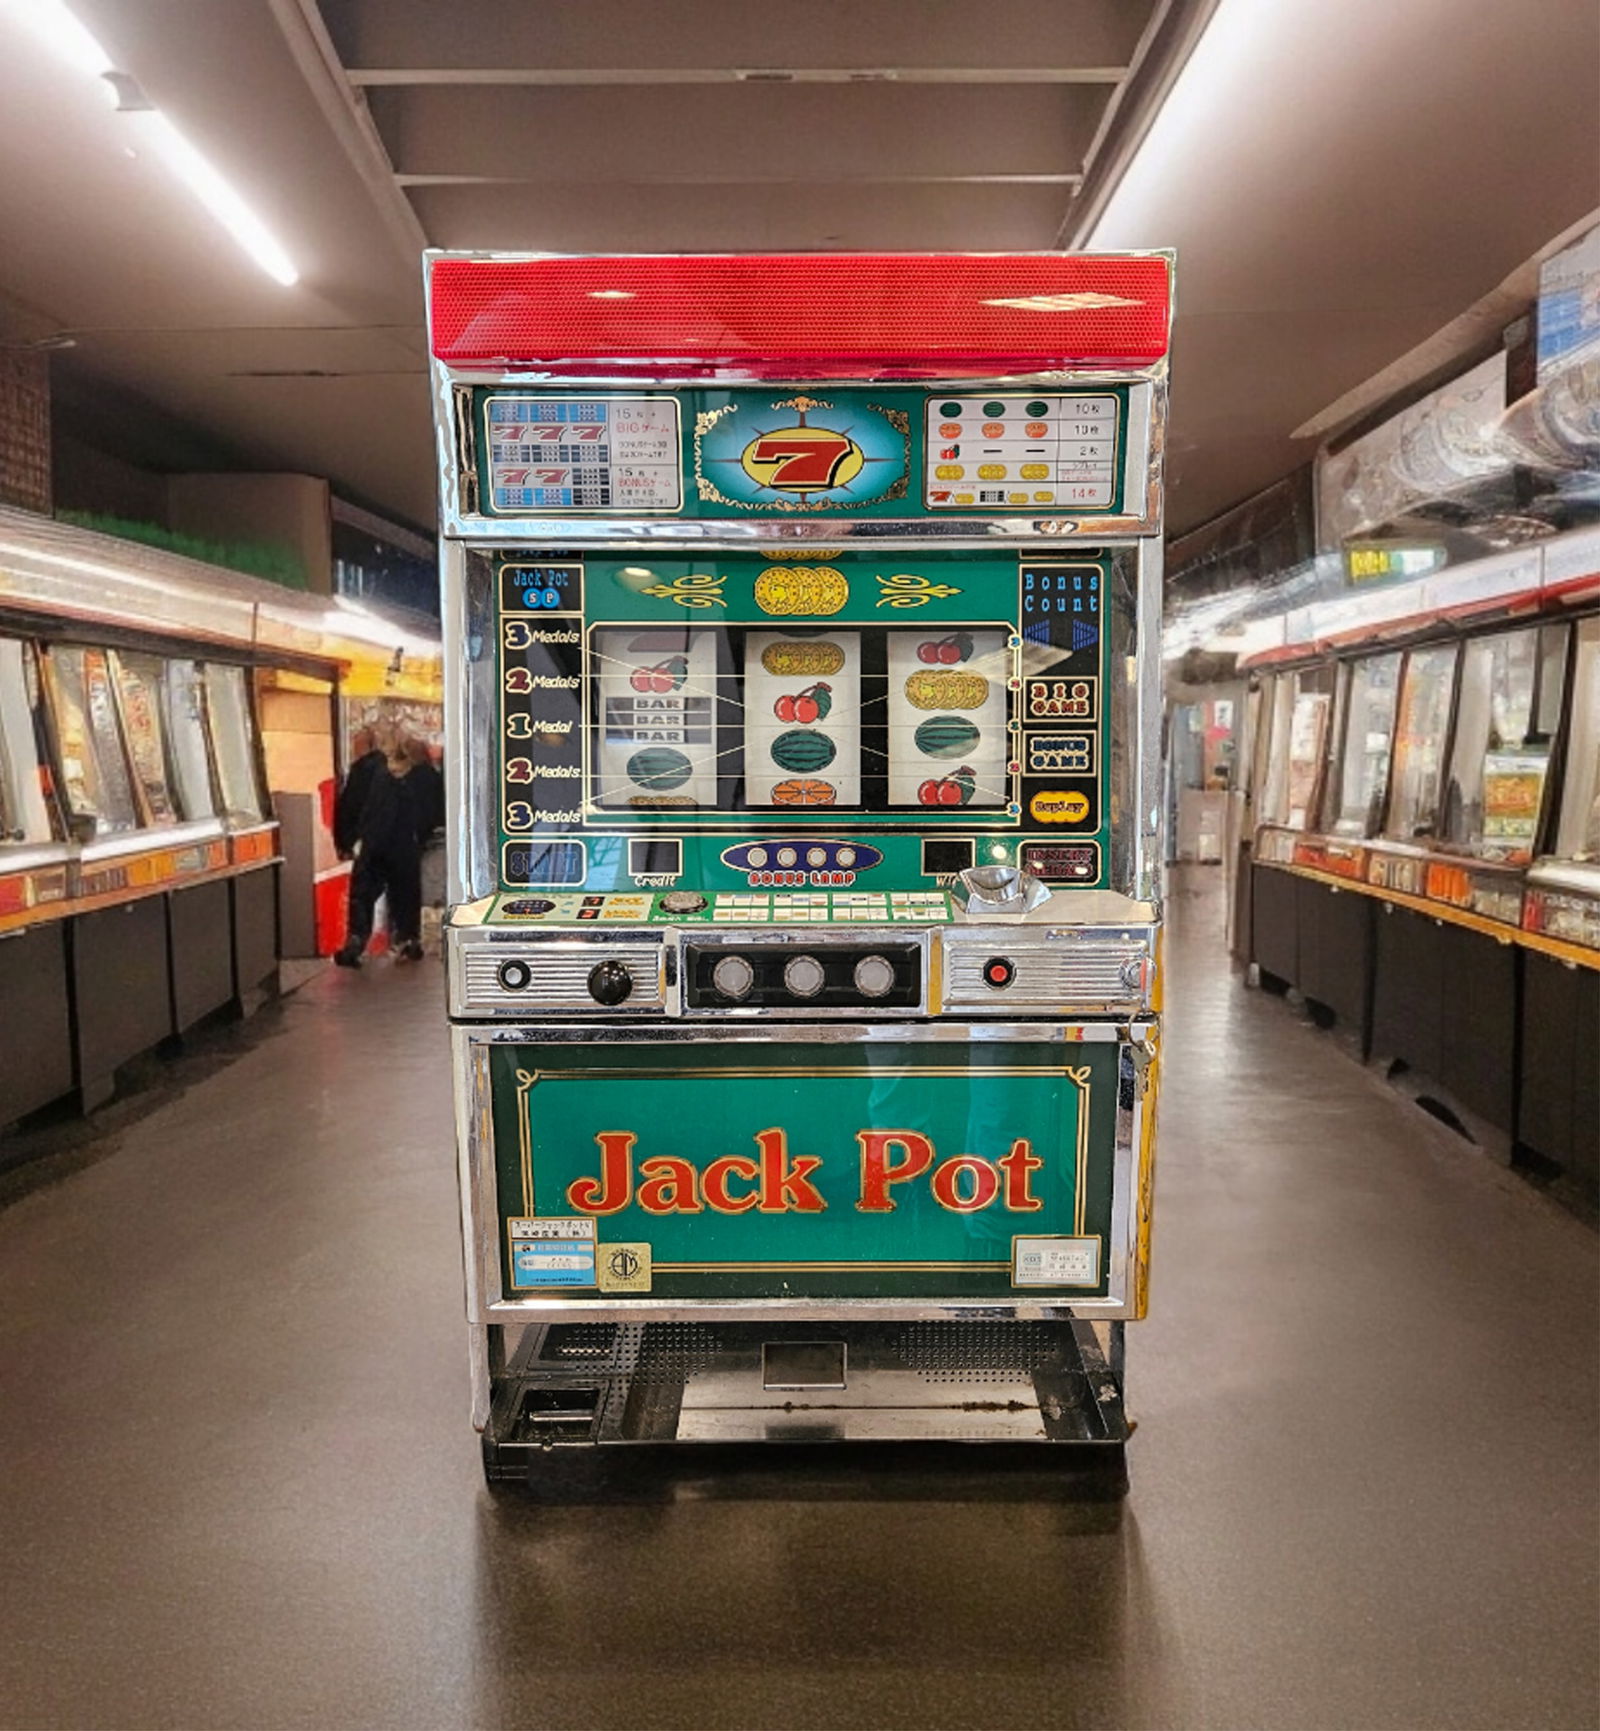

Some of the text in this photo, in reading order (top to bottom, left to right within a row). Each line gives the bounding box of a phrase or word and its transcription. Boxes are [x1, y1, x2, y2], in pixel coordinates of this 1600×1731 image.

[752, 439, 854, 489] 7
[513, 569, 569, 586] Jack Pot
[1025, 573, 1098, 590] Bonus
[1025, 595, 1098, 612] Count
[505, 621, 580, 650] 3 Medals
[505, 667, 580, 693] 2 Medals
[1031, 682, 1089, 700] BIG
[636, 700, 680, 708] BAR
[1030, 699, 1089, 716] GAME
[507, 713, 573, 738] 1 Medal
[636, 716, 680, 724] BAR
[636, 732, 680, 741] BAR
[1031, 737, 1089, 752] BONUS
[1030, 753, 1089, 770] GAME
[506, 757, 581, 784] 2 Medals
[507, 801, 582, 830] 3 Medals
[748, 870, 856, 887] BONUS LAMP
[1025, 862, 1093, 878] MEDA
[634, 875, 677, 887] Credit
[565, 1126, 1045, 1214] Jack Pot
